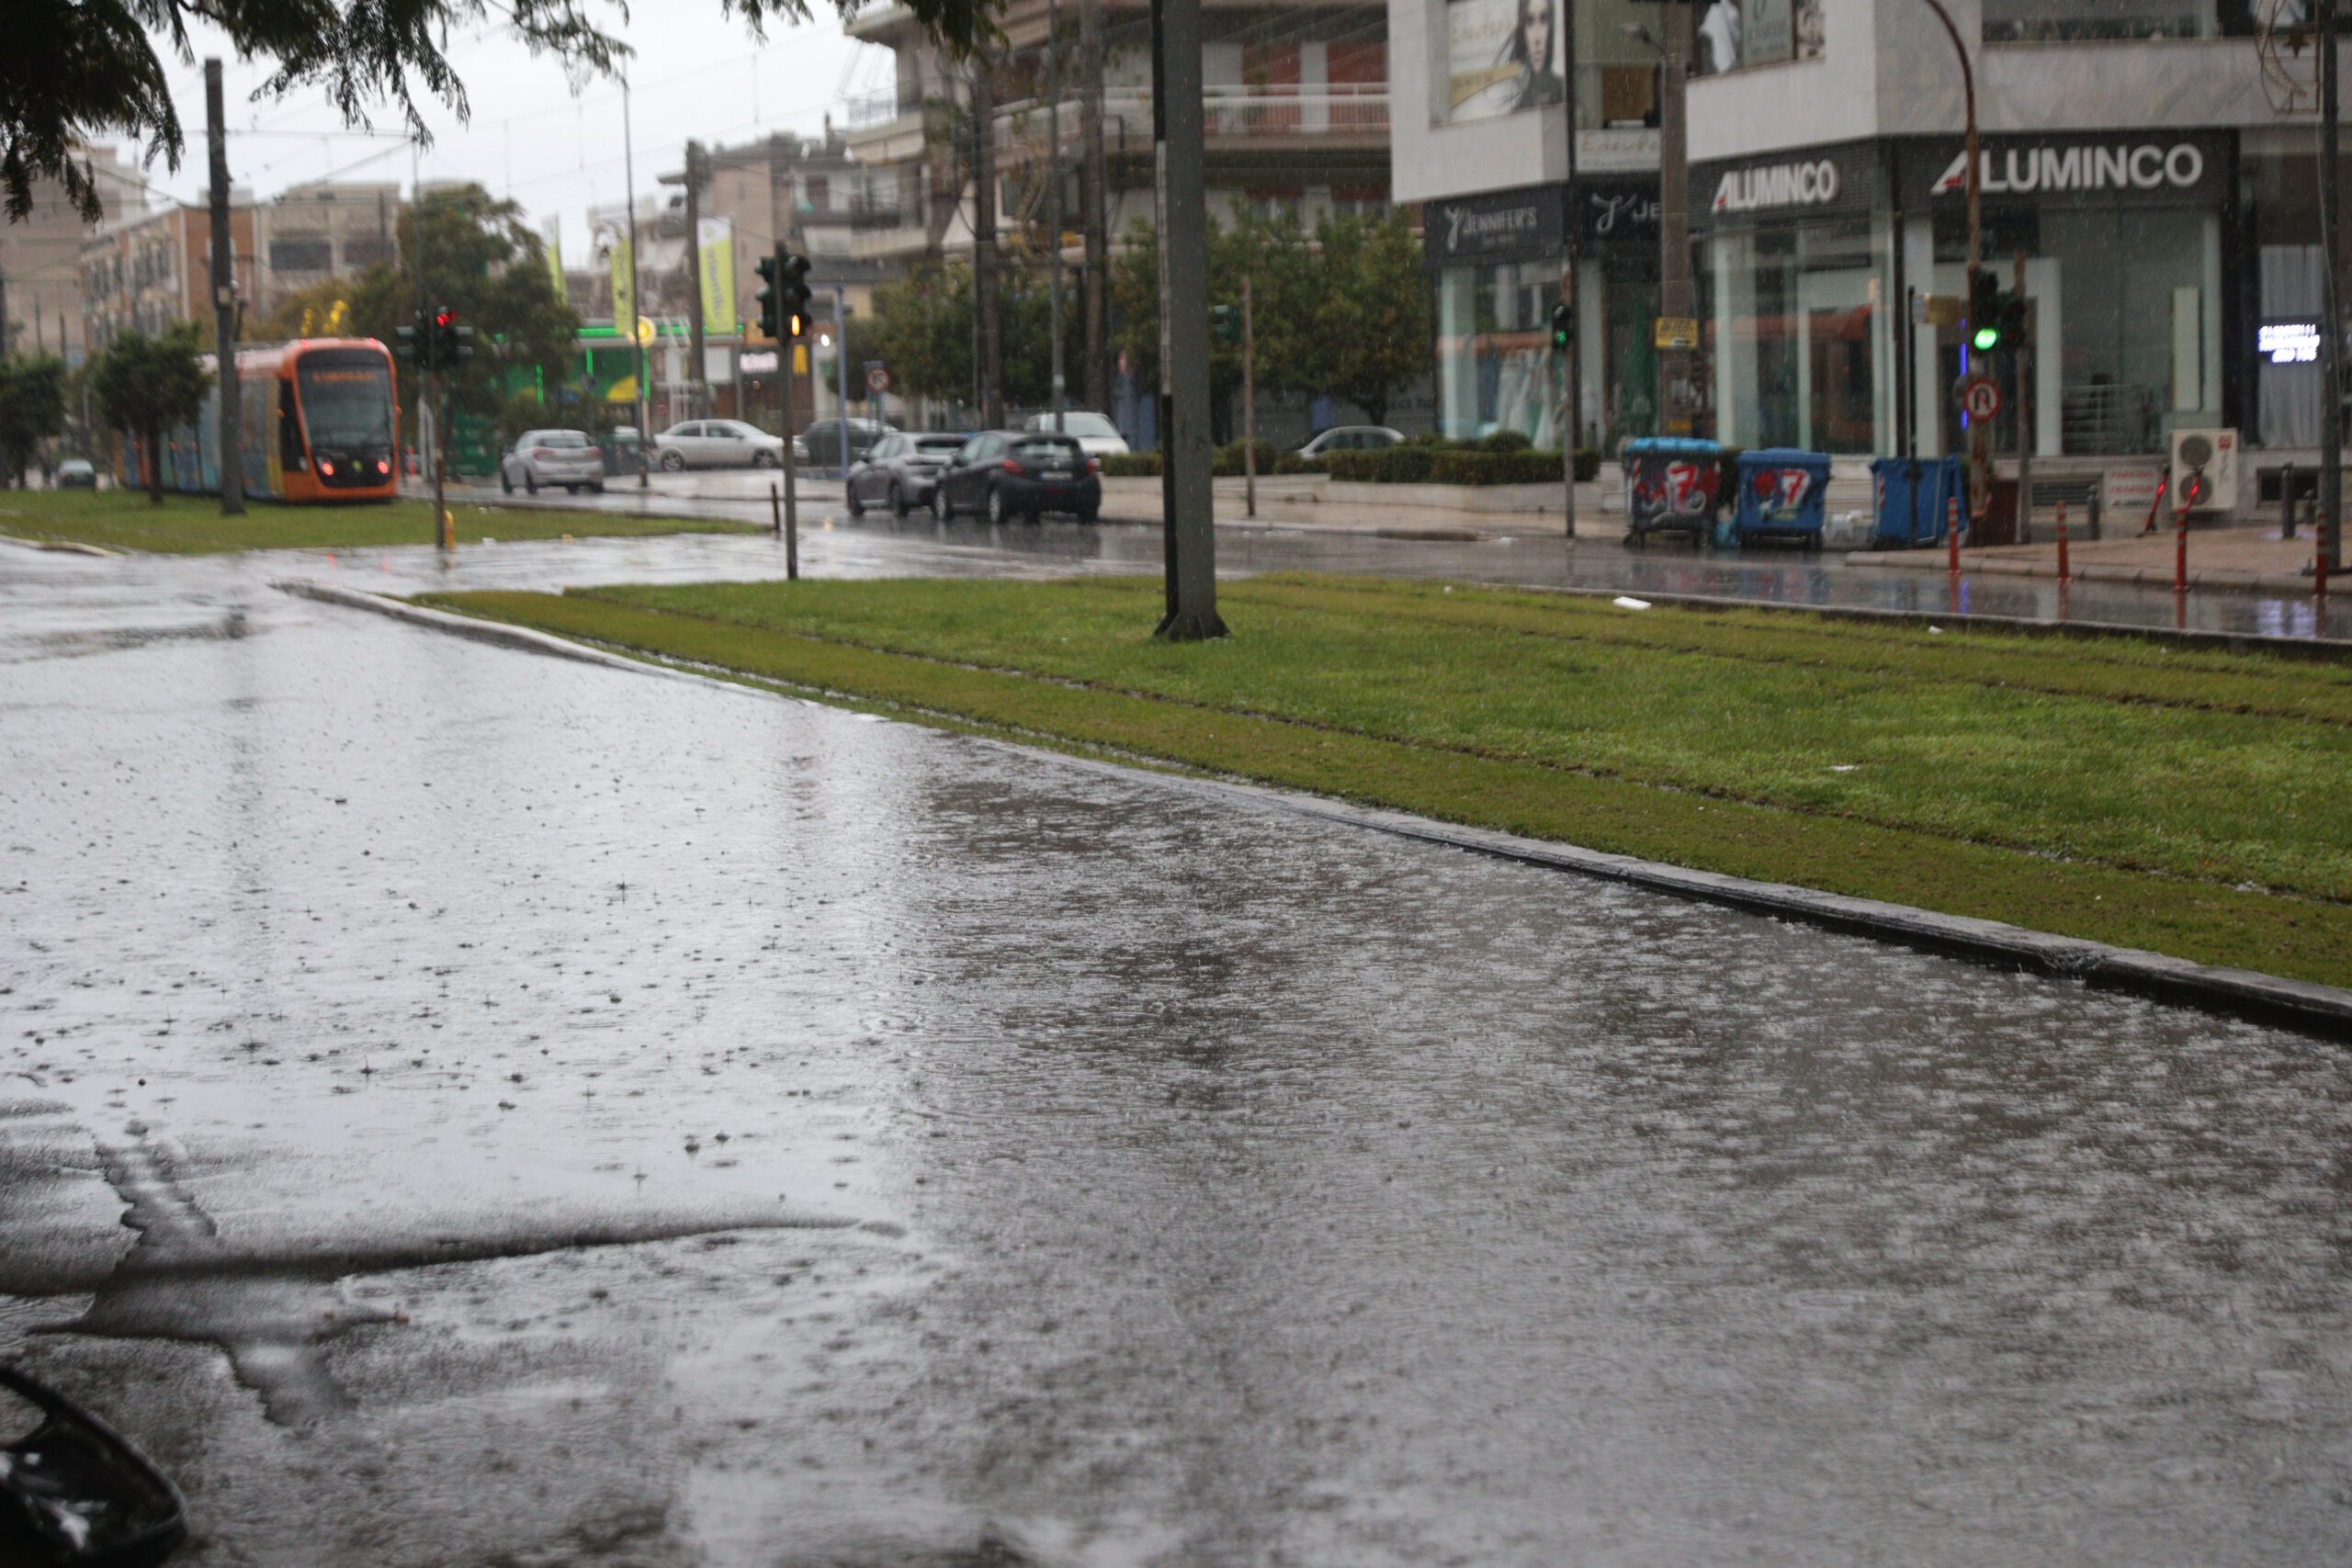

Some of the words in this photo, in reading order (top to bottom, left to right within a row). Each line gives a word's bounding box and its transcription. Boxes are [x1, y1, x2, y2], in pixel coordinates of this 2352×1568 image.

[1713, 159, 1836, 211] ALUMINCO
[1930, 143, 2202, 195] ALUMINCO
[1464, 206, 1538, 235] JENNIFER'S
